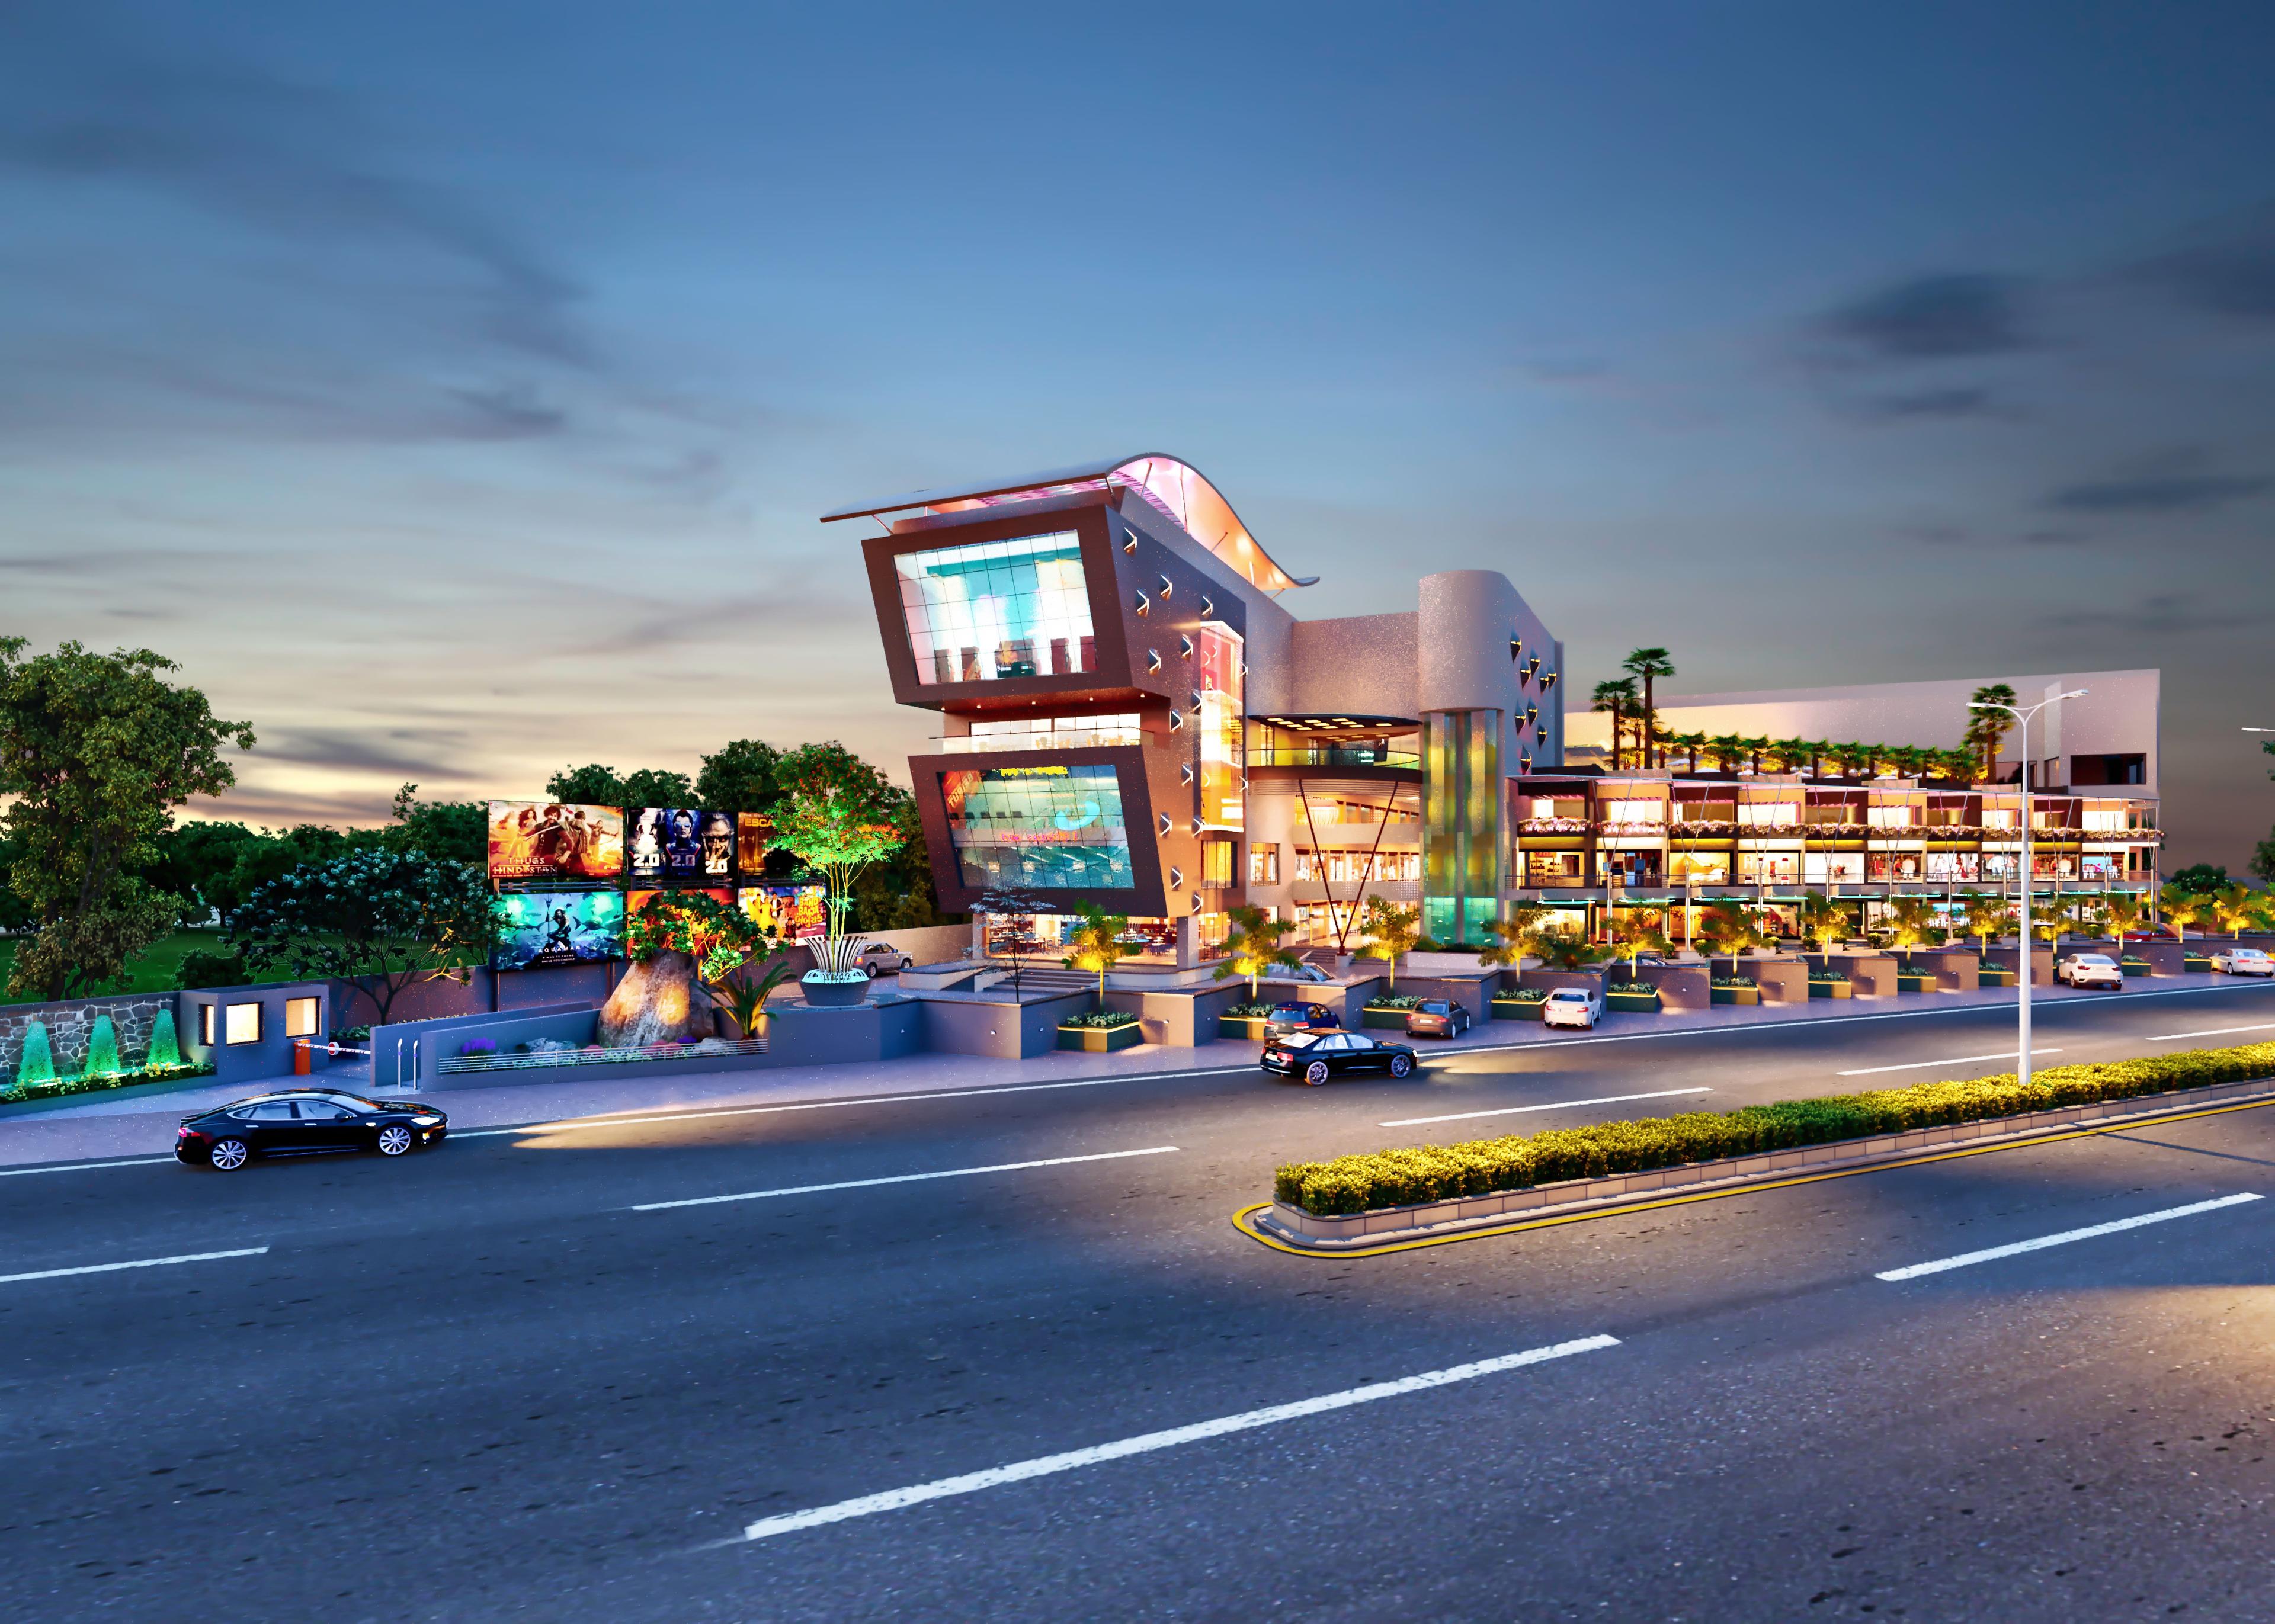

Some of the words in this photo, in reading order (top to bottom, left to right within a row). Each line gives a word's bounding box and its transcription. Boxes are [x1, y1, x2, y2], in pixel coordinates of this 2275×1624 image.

[745, 818, 773, 827] ESCA
[633, 853, 659, 866] 2.0
[672, 855, 695, 866] 2.0
[705, 861, 728, 874] 2.0
[799, 897, 818, 907] BAND
[798, 906, 819, 917] BAAJA
